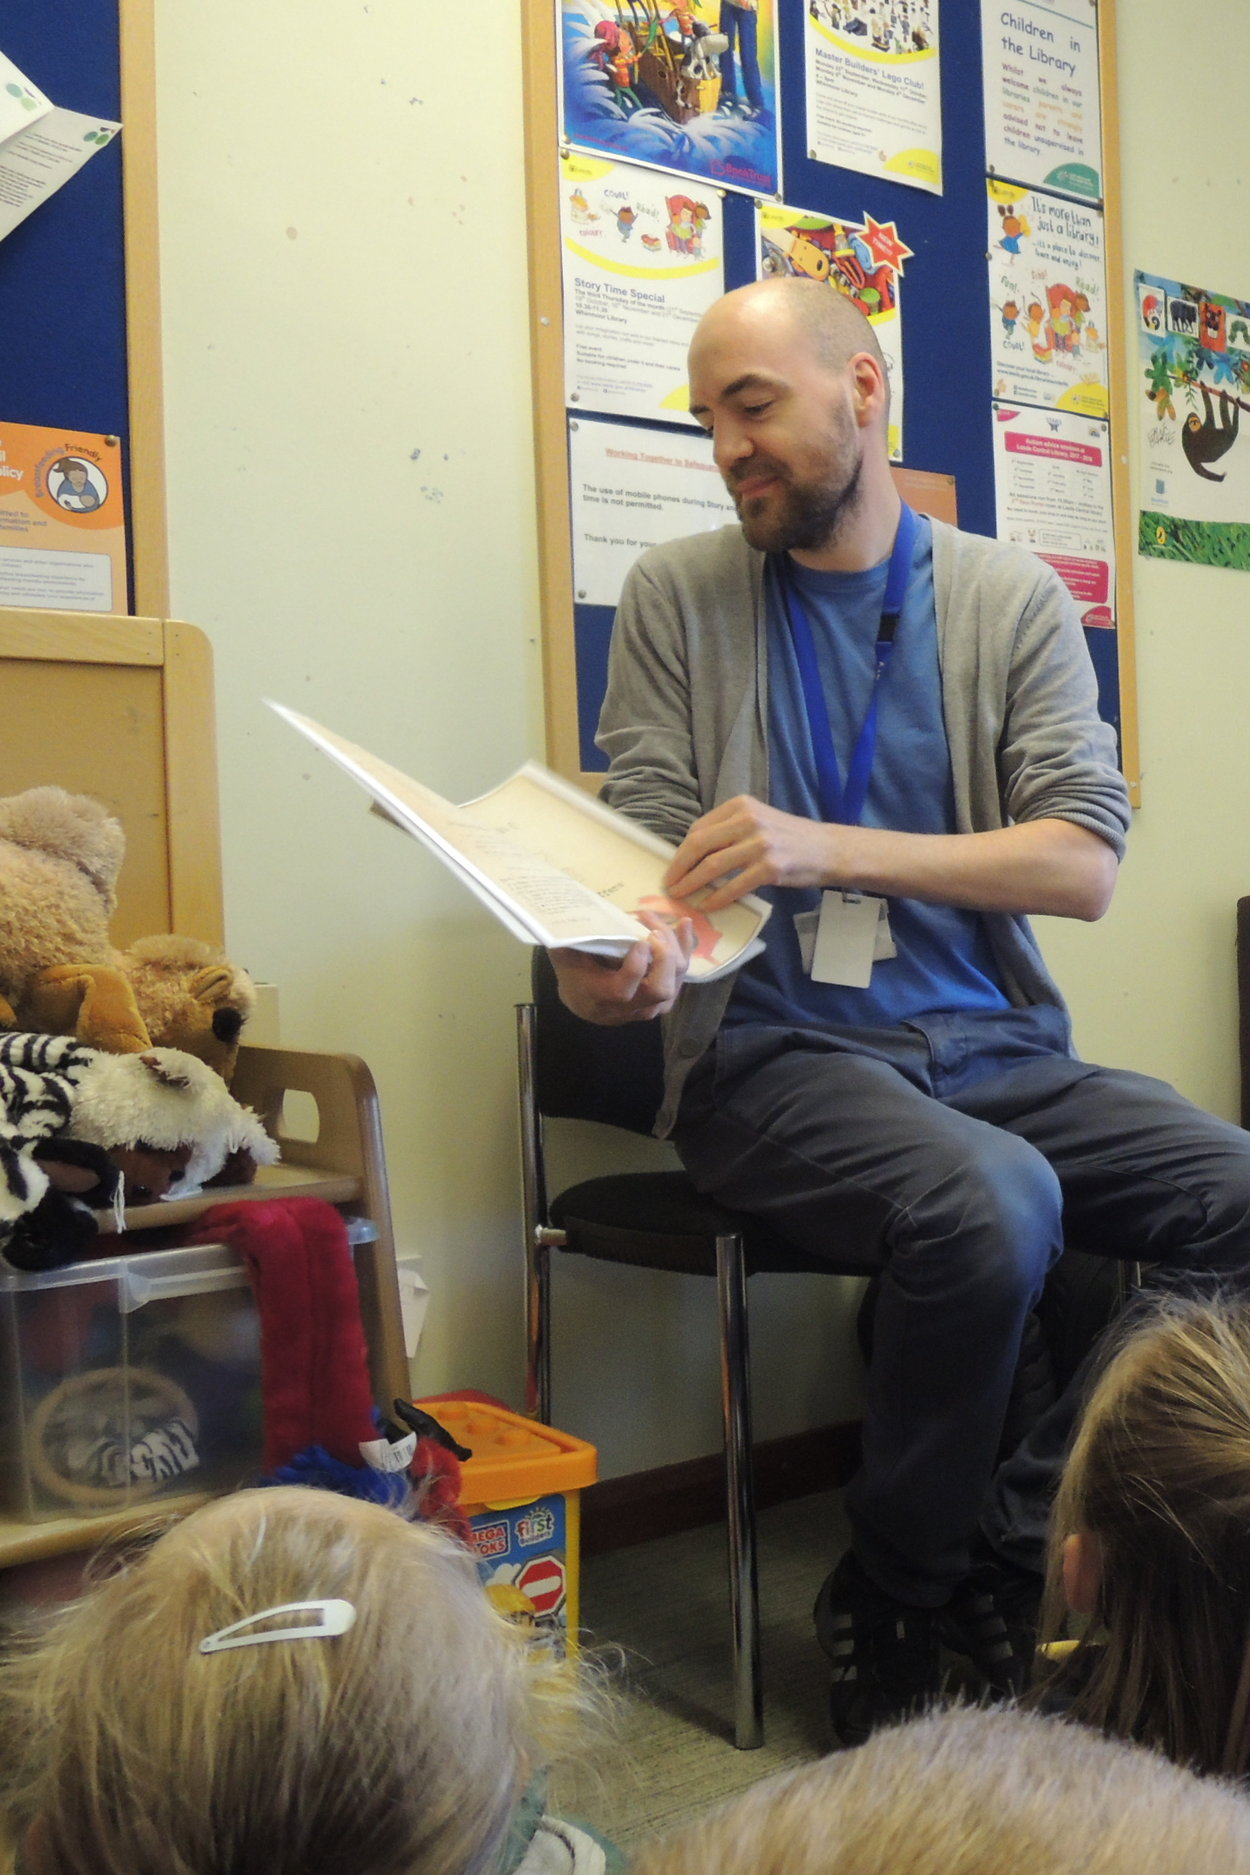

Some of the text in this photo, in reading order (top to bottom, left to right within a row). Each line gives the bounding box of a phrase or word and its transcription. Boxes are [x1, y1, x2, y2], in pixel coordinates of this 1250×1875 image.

[1000, 12, 1081, 53] Children in
[815, 48, 843, 64] Master
[881, 70, 902, 84] Lego
[1001, 37, 1076, 78] the Library
[1002, 63, 1024, 76] Whilst
[1002, 77, 1029, 90] welcome
[1037, 216, 1054, 232] just
[1056, 225, 1064, 234] a
[1048, 206, 1070, 221] more
[1070, 209, 1092, 227] than
[574, 277, 665, 304] Story Time Special
[64, 443, 102, 462] Friendly
[582, 484, 598, 494] The
[600, 487, 614, 496] use
[616, 488, 624, 496] of
[625, 490, 651, 500] mobile
[652, 493, 680, 504] phones
[682, 496, 706, 508] during
[706, 500, 724, 511] Story
[582, 494, 664, 511] time is not permitted.
[584, 533, 608, 544] Thank
[610, 537, 626, 546] you
[626, 537, 638, 546] for
